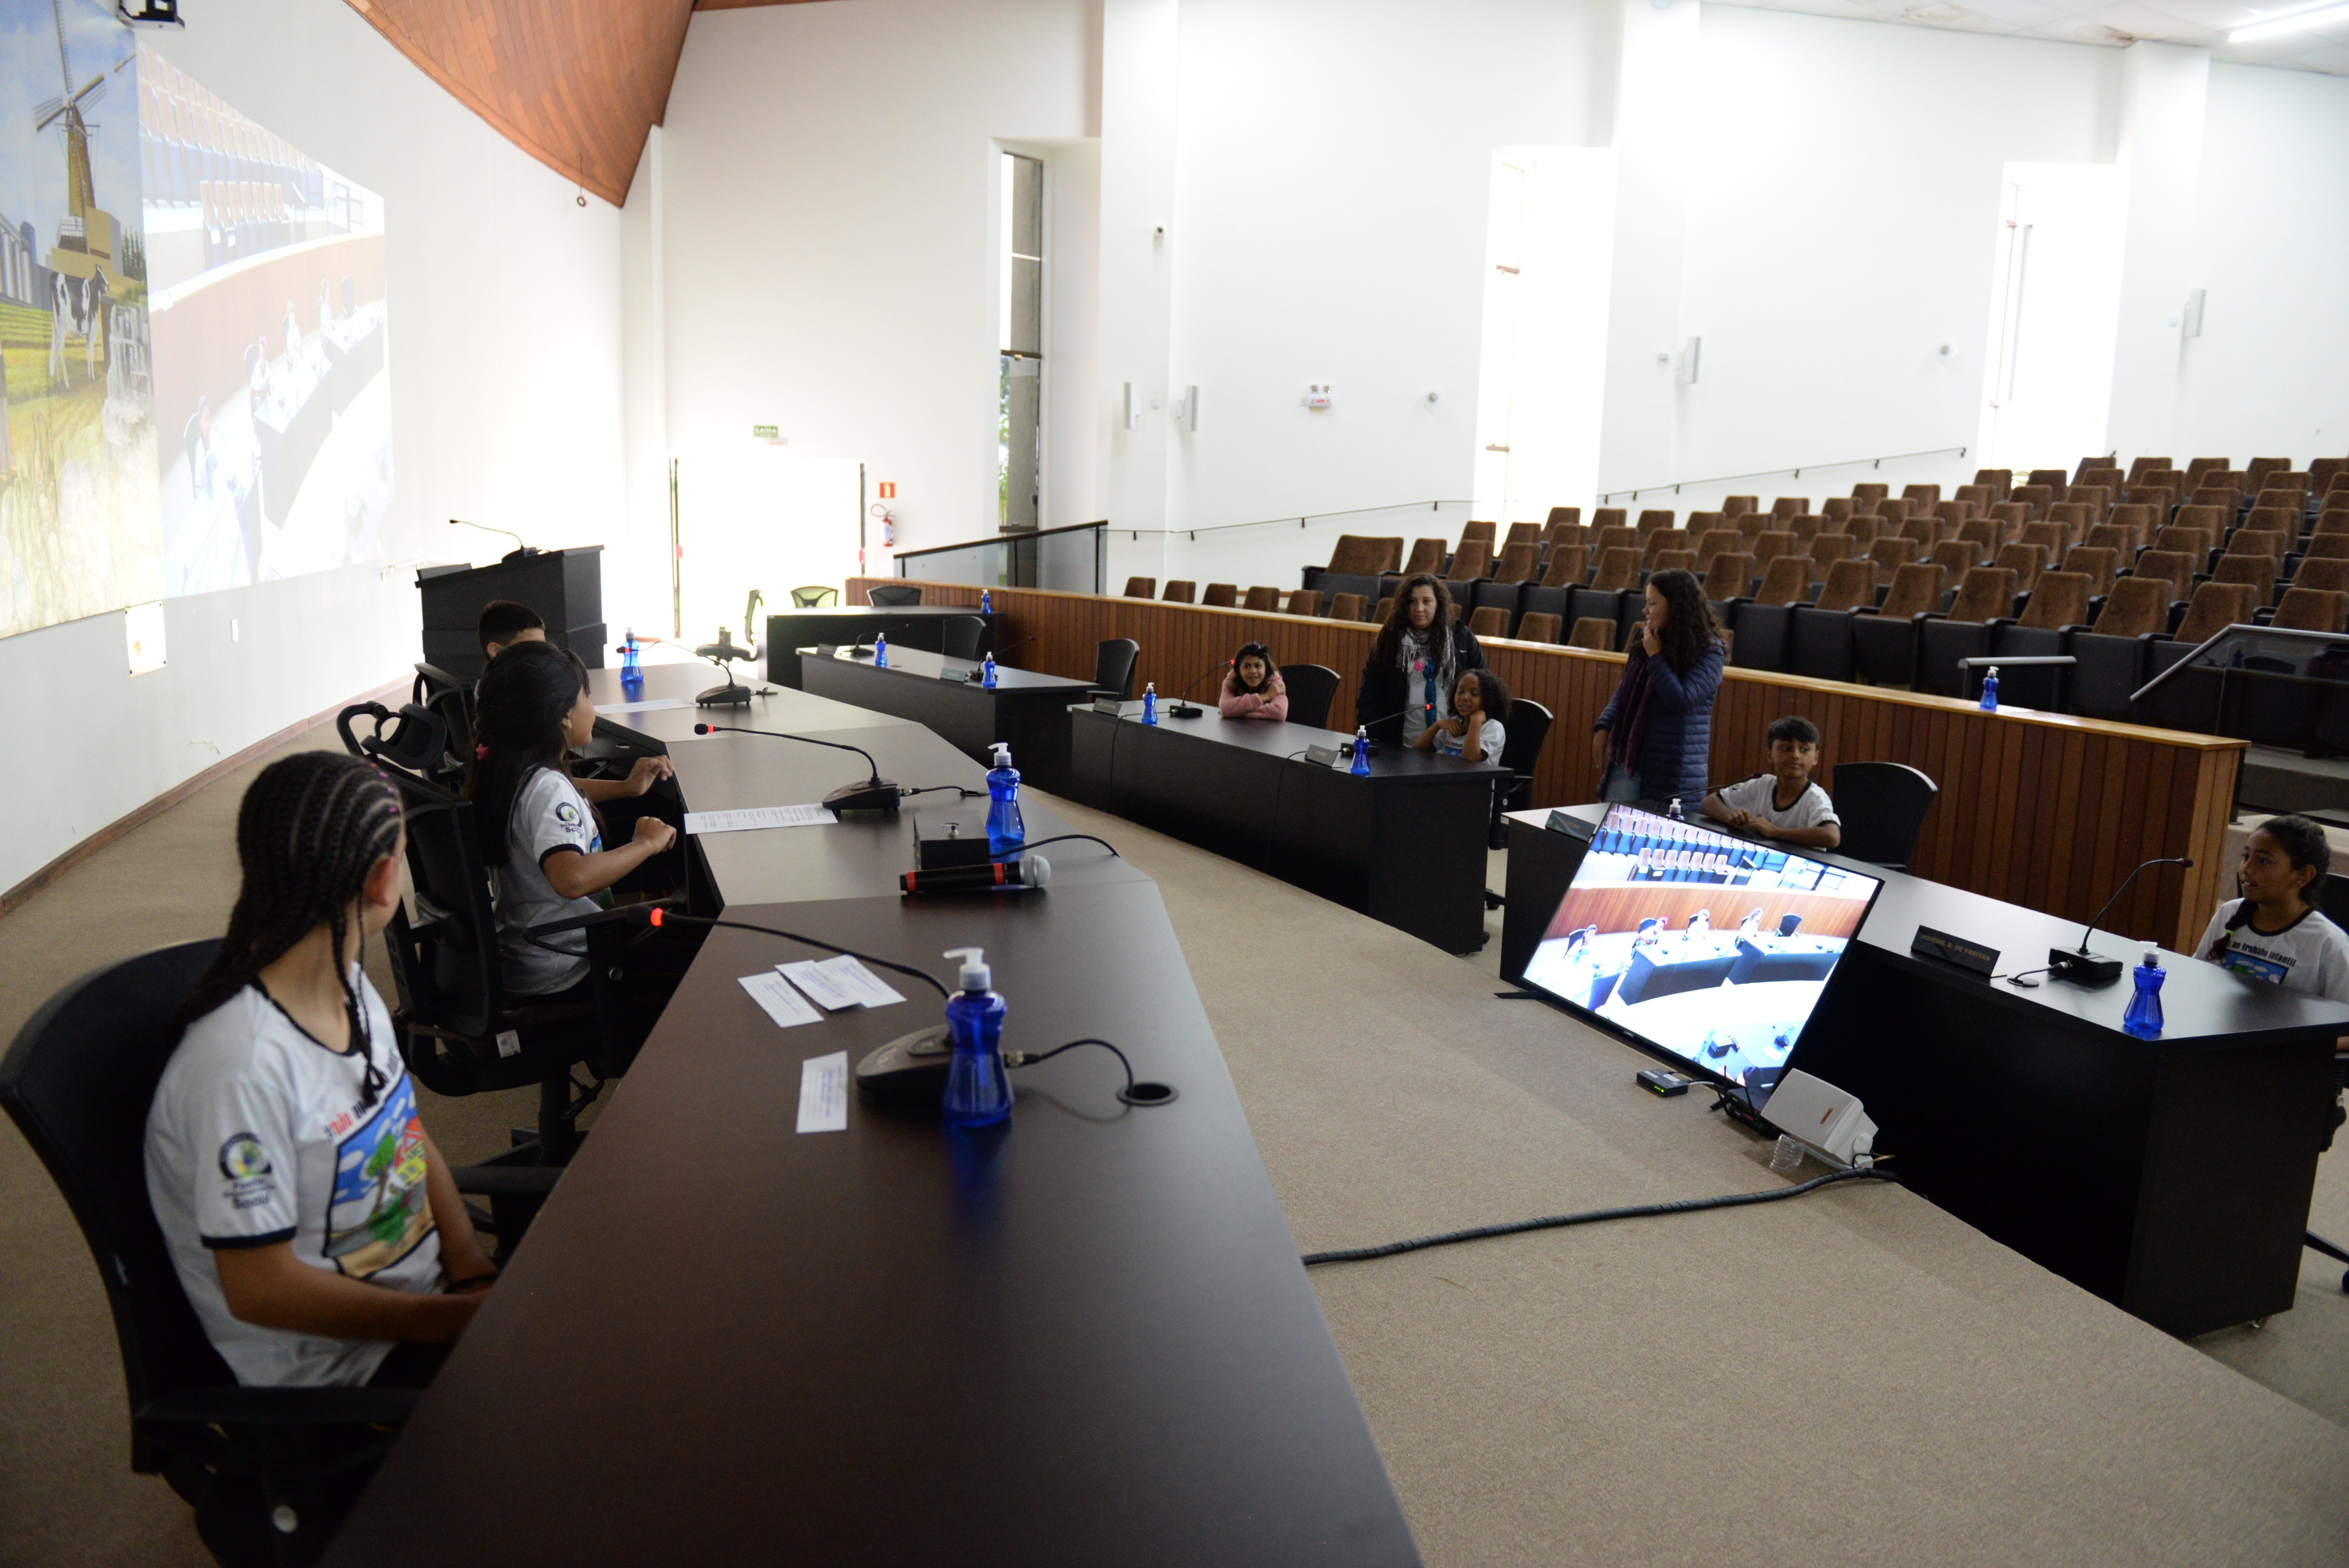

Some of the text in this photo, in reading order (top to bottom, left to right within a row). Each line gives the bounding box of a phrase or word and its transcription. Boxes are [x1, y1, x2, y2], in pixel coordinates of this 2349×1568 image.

[1921, 934, 1946, 947] JOVENIL
[1955, 944, 1964, 953] DE
[1964, 947, 1991, 961] FREITAS
[2268, 951, 2297, 967] infantil
